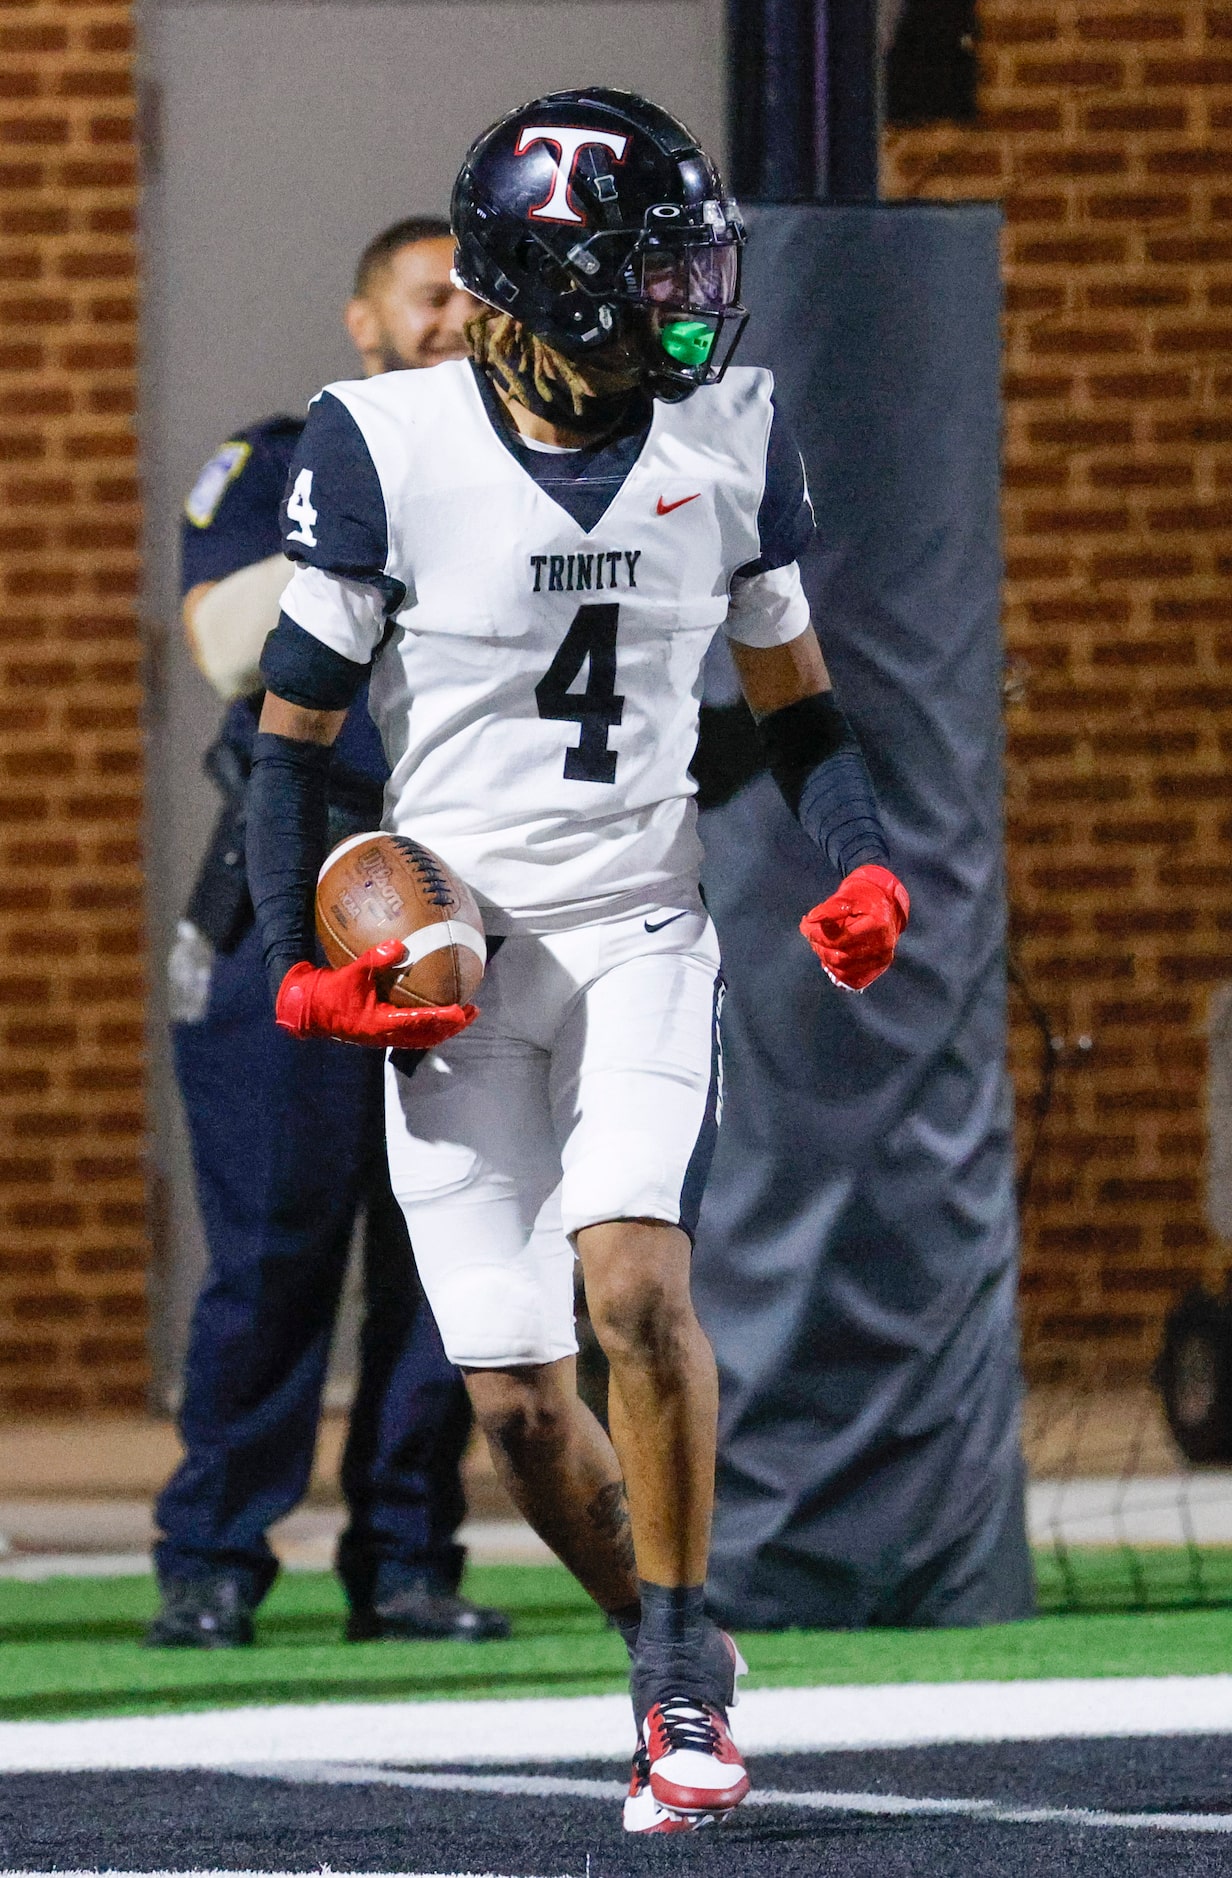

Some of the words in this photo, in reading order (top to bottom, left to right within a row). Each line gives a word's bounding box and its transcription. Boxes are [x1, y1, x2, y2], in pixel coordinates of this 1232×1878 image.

[514, 124, 633, 226] T
[287, 468, 318, 547] 4
[530, 550, 642, 593] TRINITY
[535, 602, 625, 784] 4
